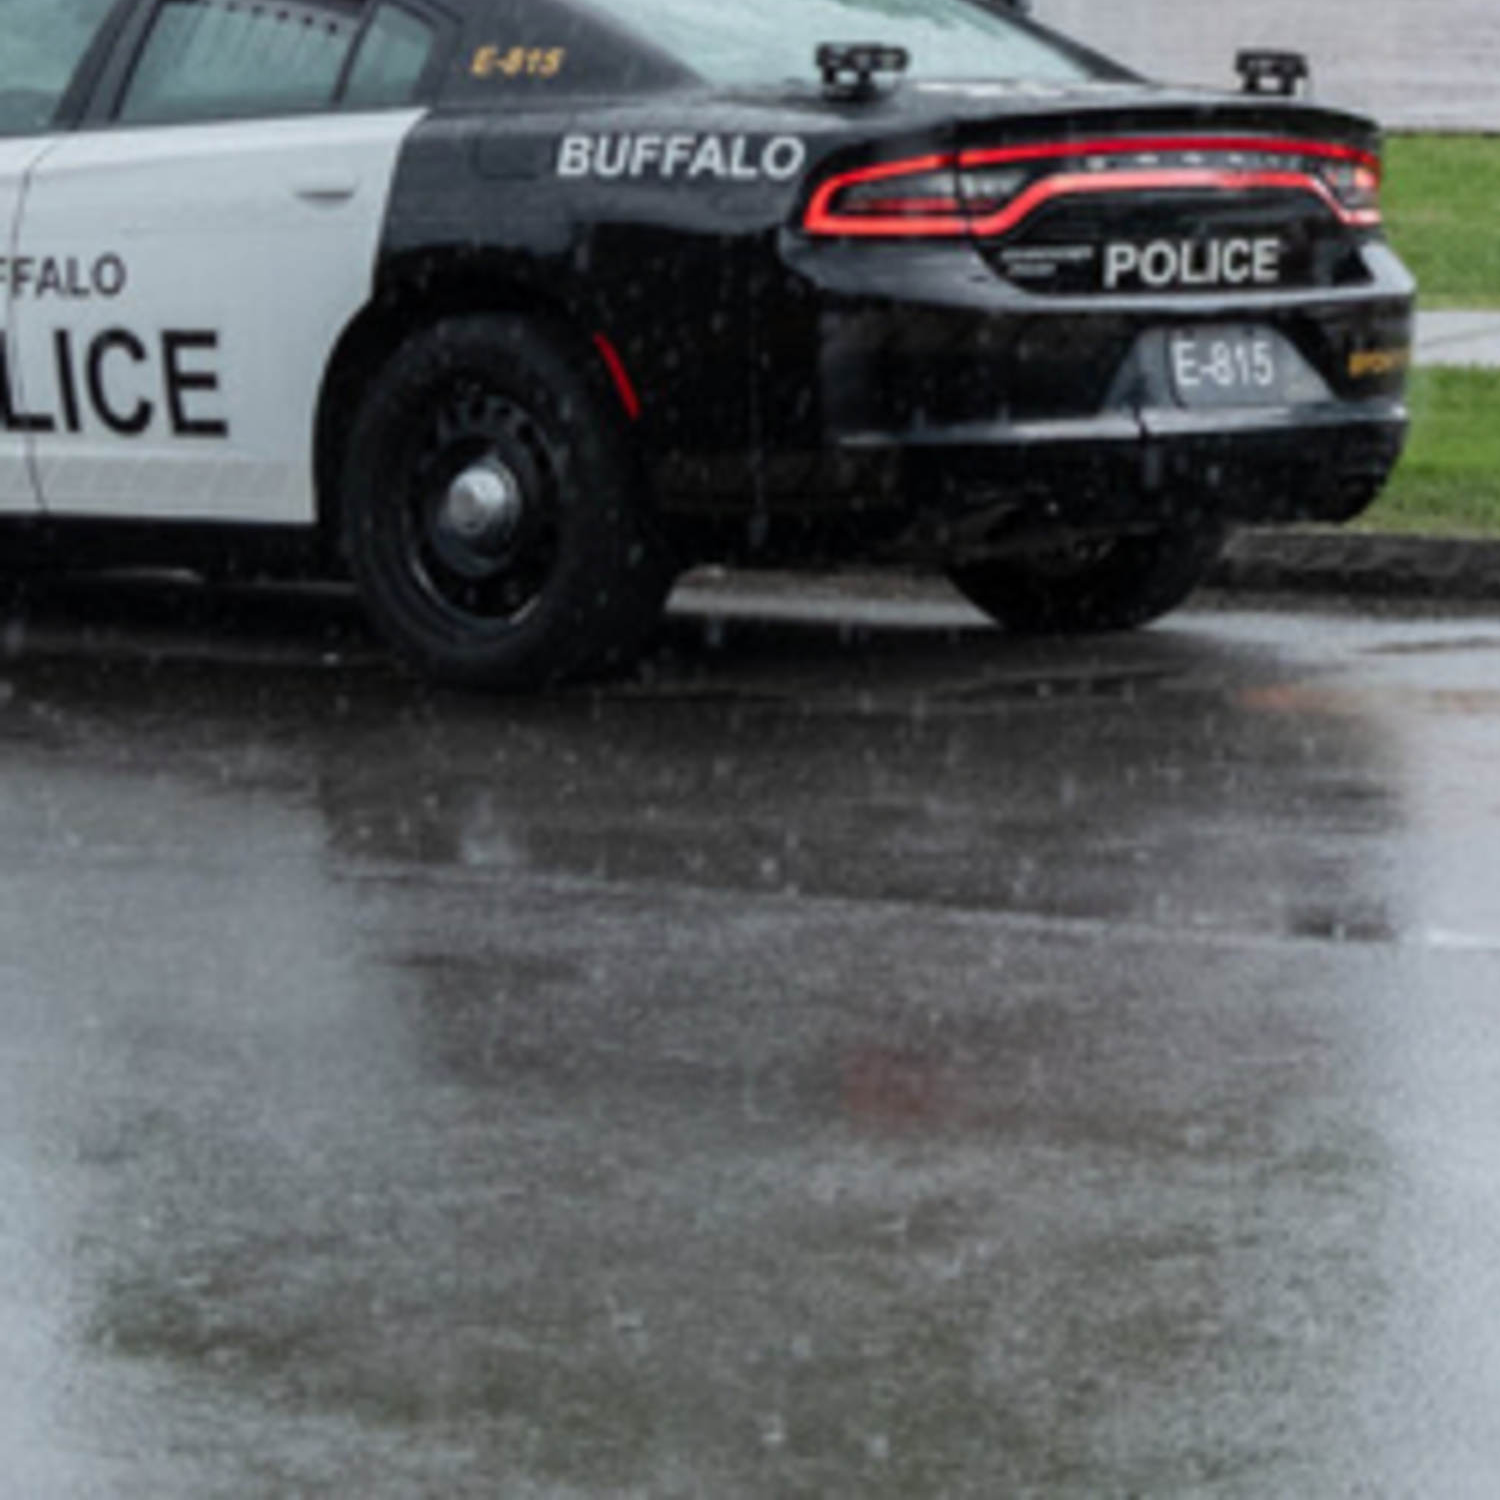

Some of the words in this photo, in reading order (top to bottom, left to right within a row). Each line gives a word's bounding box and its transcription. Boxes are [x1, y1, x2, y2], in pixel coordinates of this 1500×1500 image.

[556, 134, 806, 180] BUFFALO
[1103, 239, 1280, 288] POLICE
[1171, 340, 1273, 386] E-815
